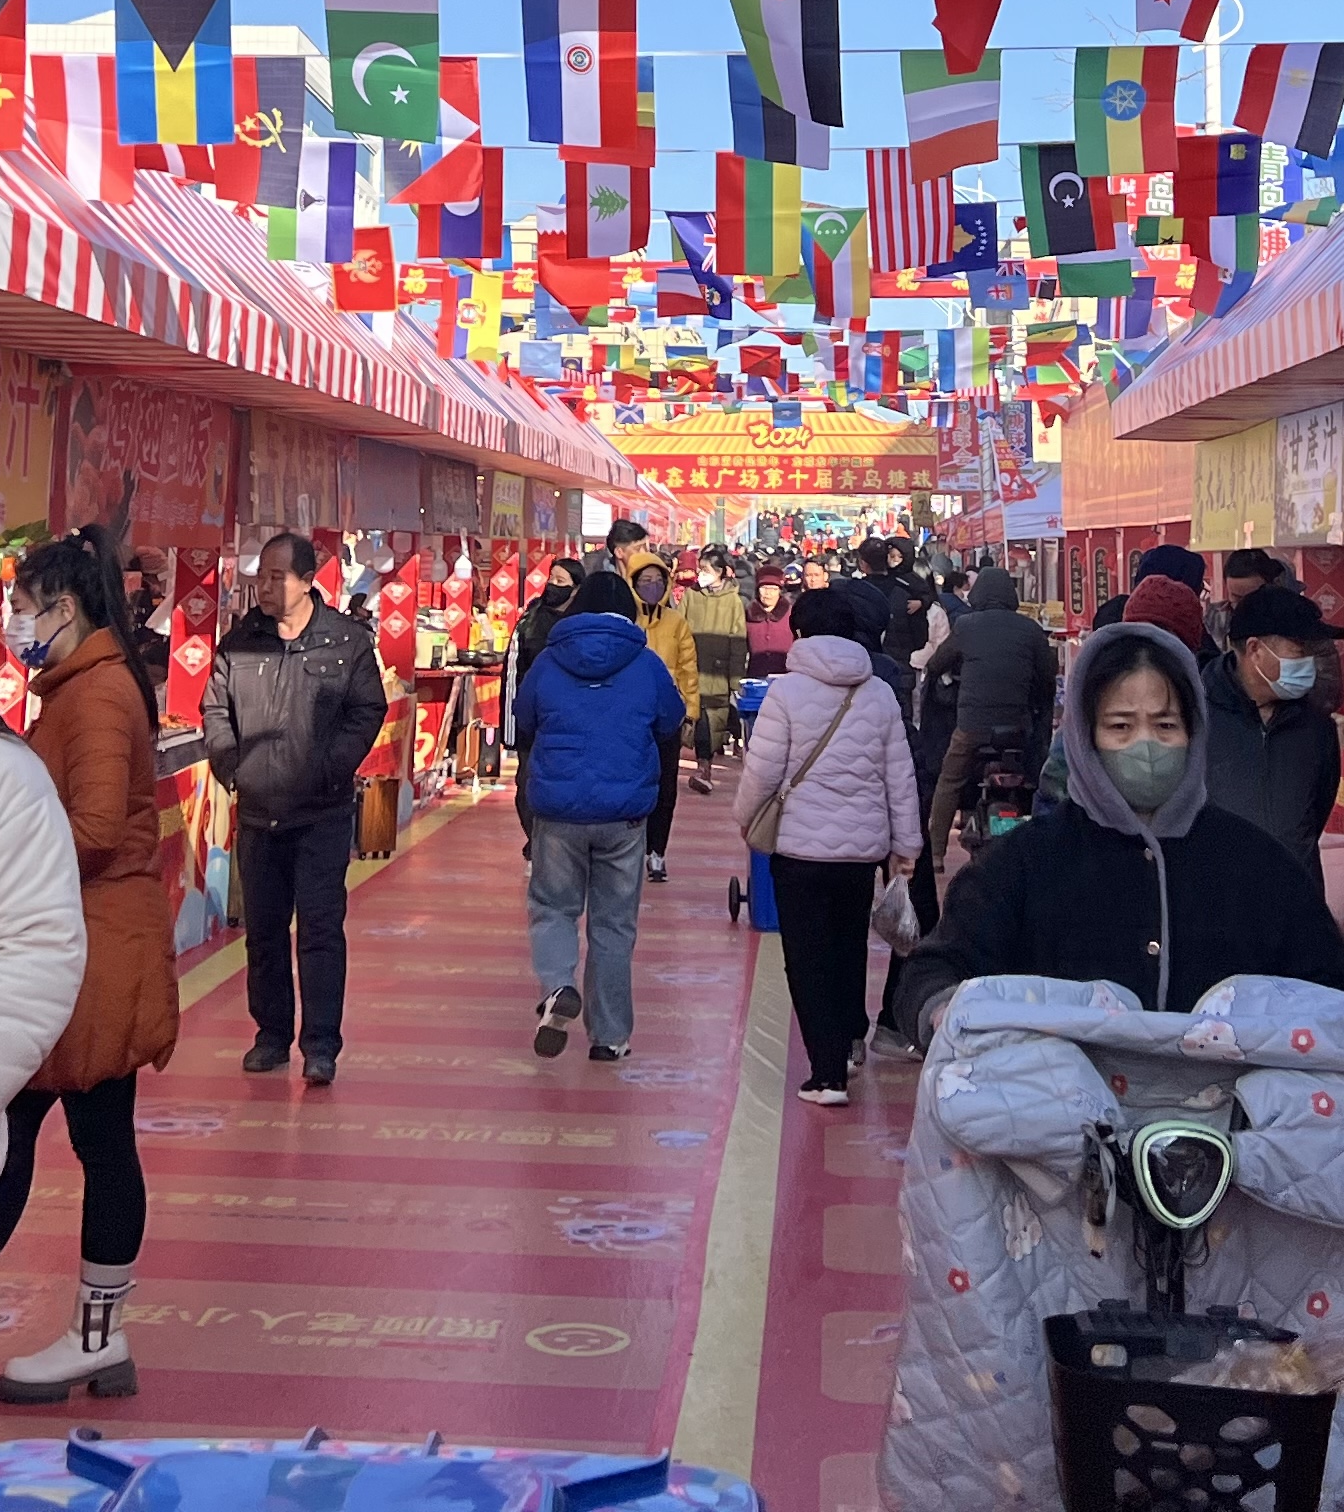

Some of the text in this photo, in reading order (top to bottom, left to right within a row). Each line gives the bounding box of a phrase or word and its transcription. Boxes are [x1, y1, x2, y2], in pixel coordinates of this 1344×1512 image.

[749, 421, 811, 449] 2024
[1289, 408, 1338, 476] 甘蔗汁
